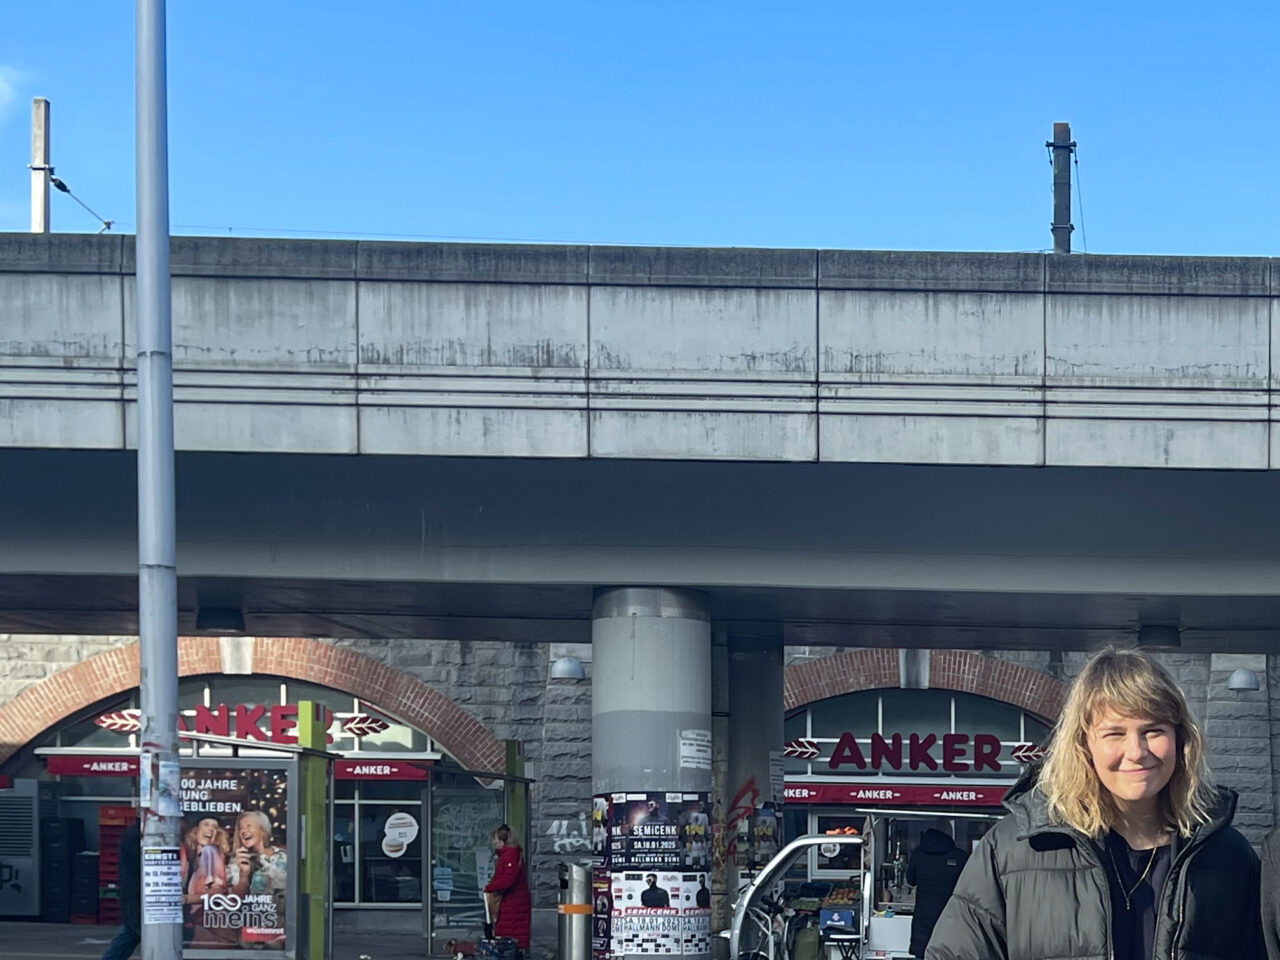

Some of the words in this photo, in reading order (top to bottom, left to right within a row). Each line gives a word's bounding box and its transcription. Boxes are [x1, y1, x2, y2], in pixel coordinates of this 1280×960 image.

[179, 703, 333, 745] NKE
[828, 731, 1002, 772] ANKER
[197, 779, 238, 790] JAHRE
[242, 895, 273, 904] JAHRE
[251, 904, 277, 912] GANZ
[203, 905, 278, 928] meins
